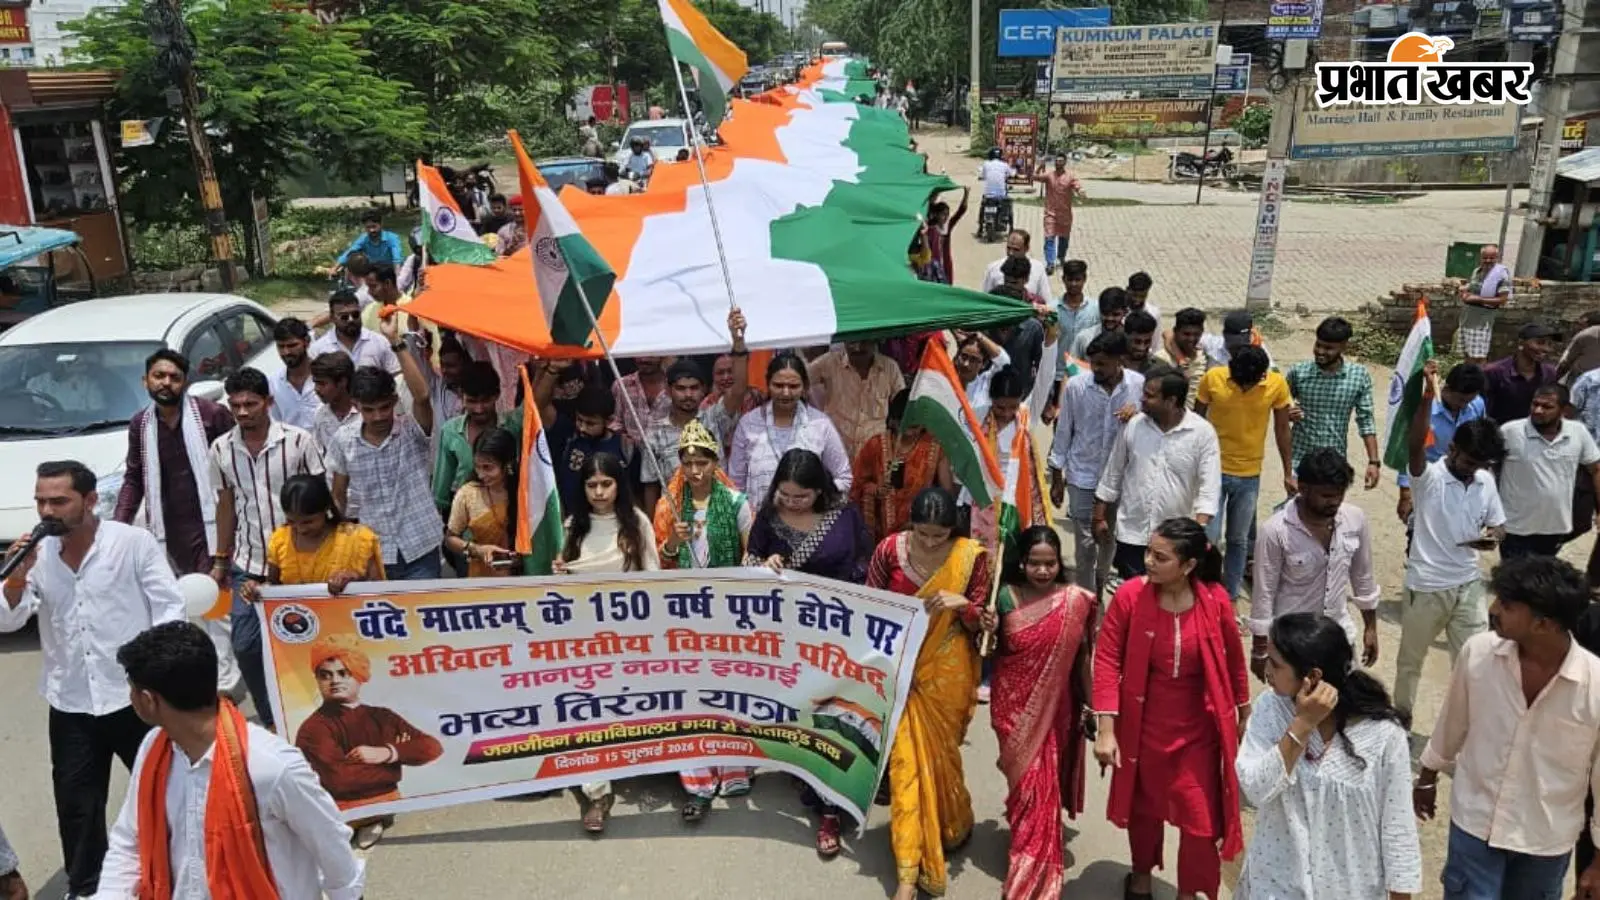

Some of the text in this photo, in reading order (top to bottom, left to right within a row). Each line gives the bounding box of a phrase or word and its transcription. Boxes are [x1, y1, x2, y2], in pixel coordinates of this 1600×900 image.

[1003, 26, 1055, 41] CER
[1062, 26, 1214, 42] KUMKUM PALACE
[1064, 101, 1207, 114] KUMKUM FAMILY RESTAURANT
[1306, 107, 1505, 125] Marriage Hall & Family Restaurant
[353, 601, 407, 639] वंदे
[417, 601, 534, 634] मातरम्
[537, 591, 573, 625] के
[589, 590, 651, 623] 150
[664, 586, 714, 619] वर्ष
[725, 588, 785, 630] पूर्ण
[795, 592, 854, 637] होने
[864, 612, 903, 656] पर
[387, 628, 888, 702] अखिल भारतीय विद्यार्थी परिषद्
[501, 659, 802, 690] मानपुर नगर इकाई
[439, 686, 801, 737] भव्य तिरंगा यात्रा
[481, 733, 570, 757] जगजीवन
[575, 718, 679, 745] महाविद्यालय
[681, 718, 718, 731] गया
[721, 719, 737, 733] से
[814, 738, 842, 760] तक
[554, 737, 754, 770] दिनांक 15 जुलाई 2026 (बुधवार)
